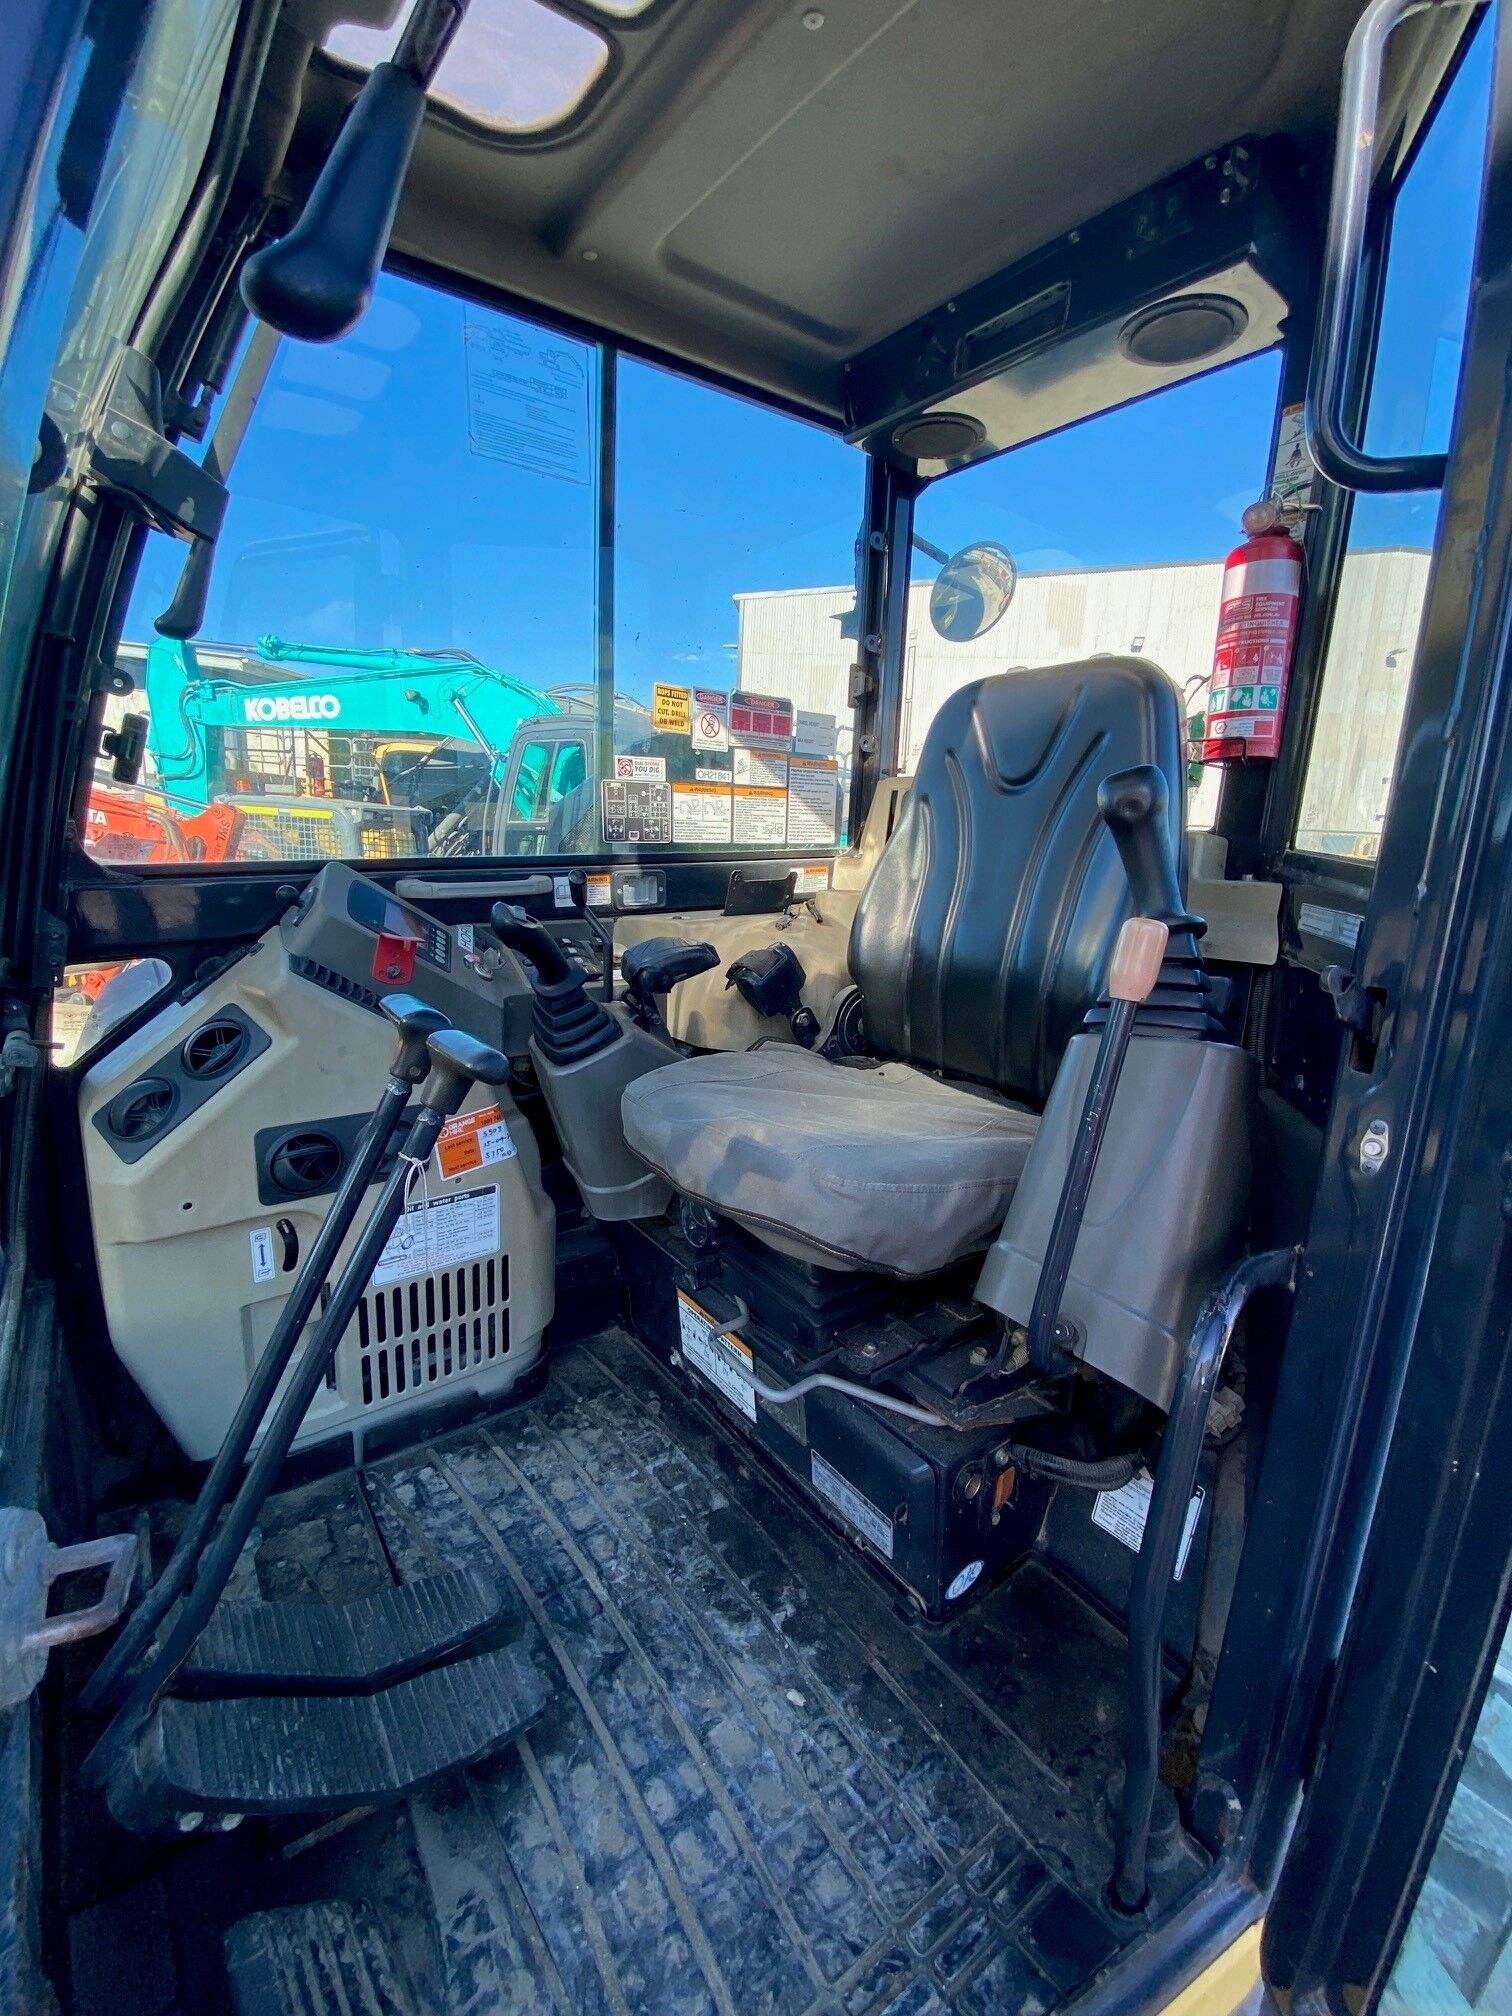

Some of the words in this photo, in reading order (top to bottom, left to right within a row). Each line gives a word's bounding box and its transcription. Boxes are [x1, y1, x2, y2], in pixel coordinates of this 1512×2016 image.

[657, 687, 671, 696] ROPS
[672, 690, 688, 699] FITTED
[244, 694, 341, 722] KOBELCO
[750, 700, 775, 709] DANGER
[657, 708, 670, 716] CUT,
[671, 710, 687, 719] DRILL
[669, 719, 685, 727] WELD
[635, 765, 648, 773] YOU
[449, 1117, 476, 1129] ORANGE
[432, 1197, 452, 1206] water
[454, 1193, 470, 1203] ports
